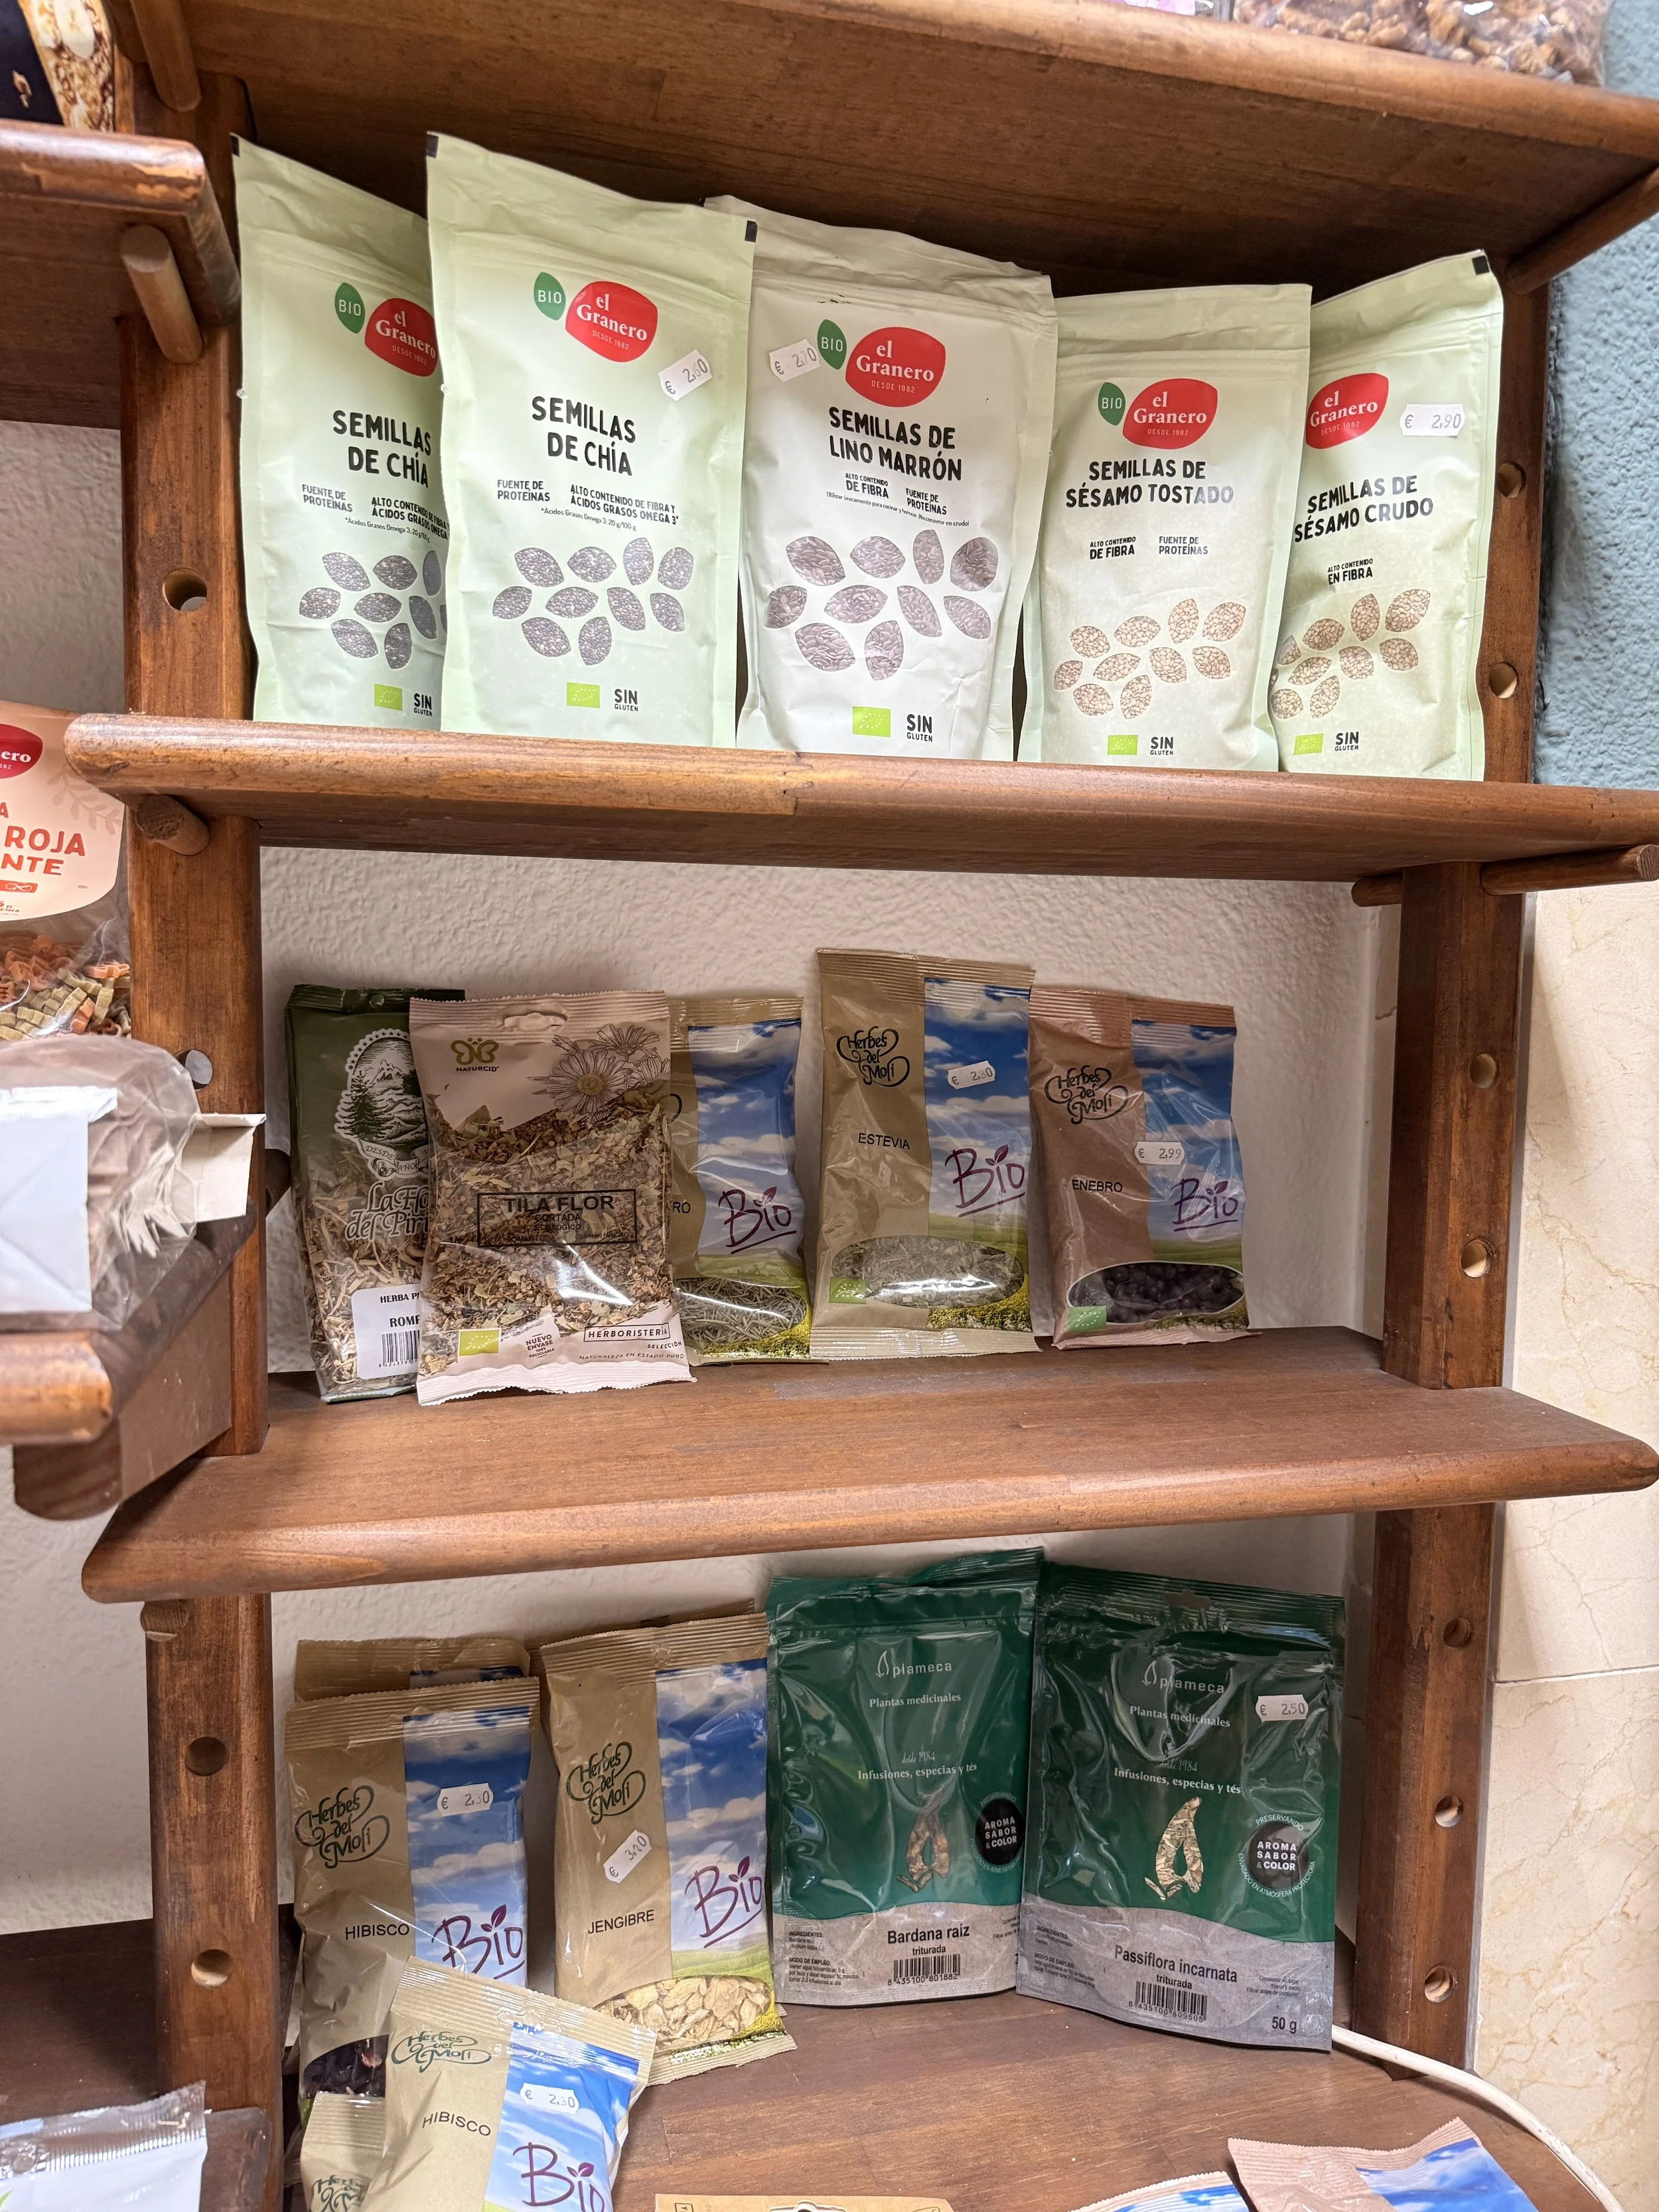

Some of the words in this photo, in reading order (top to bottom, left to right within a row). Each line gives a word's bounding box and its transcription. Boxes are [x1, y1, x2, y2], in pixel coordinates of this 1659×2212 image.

[538, 290, 562, 304] BIO
[596, 293, 610, 311] el
[339, 300, 361, 316] BIO
[394, 311, 406, 327] el
[576, 303, 648, 341] Granero
[821, 336, 843, 352] BIO
[876, 340, 893, 358] el
[774, 361, 784, 375] €
[856, 356, 934, 382] Granero
[666, 380, 676, 394] €
[1102, 397, 1122, 409] BIO
[1152, 391, 1167, 407] el
[1324, 391, 1339, 408] el
[532, 396, 636, 443] SEMILLAS
[1133, 408, 1207, 424] Granero
[1309, 402, 1379, 427] Granero
[1404, 414, 1413, 429] €
[1431, 413, 1462, 429] 2,90
[332, 409, 431, 456] SEMILLAS
[829, 407, 922, 446] SEMILLAS
[928, 425, 956, 449] DE
[547, 432, 578, 461] DE
[584, 441, 633, 476] CHÍA
[830, 435, 873, 464] LINO
[879, 446, 962, 481] MARRÓN
[348, 447, 380, 475] DE
[387, 451, 429, 488] CHÍA
[1089, 459, 1177, 480] SEMILLAS
[1183, 461, 1206, 479] DE
[302, 484, 332, 498] FUENTE
[334, 490, 346, 500] DE
[497, 480, 530, 489] FUENTE
[532, 481, 543, 490] DE
[846, 480, 859, 492] DE
[862, 482, 889, 499] FIBRA
[906, 488, 928, 501] FUENTE
[930, 494, 939, 503] DE
[1066, 482, 1142, 508] SÉSAMO
[1148, 484, 1234, 504] TOSTADO
[1307, 478, 1386, 514] SEMILLAS
[1392, 475, 1417, 495] DE
[1294, 506, 1360, 543] SÉSAMO
[1364, 498, 1434, 523] CRUDO
[1090, 548, 1103, 559] DE
[1106, 544, 1135, 558] FIBRA
[1328, 572, 1340, 585] EN
[1342, 566, 1373, 583] FIBRA
[414, 693, 432, 709] SIN
[614, 689, 638, 705] SIN
[614, 703, 638, 711] GLUTEN
[907, 714, 932, 733] SIN
[907, 732, 933, 743] GLUTEN
[1151, 737, 1174, 750] SIN
[1335, 732, 1359, 745] SIN
[5, 826, 86, 856] ROJA
[839, 1026, 893, 1055] Herbes
[952, 1076, 959, 1085] €
[1050, 1065, 1107, 1092] Herbes
[858, 1132, 910, 1151] ESTEVIA
[1138, 1147, 1144, 1159] €
[1159, 1147, 1181, 1159] 2,99
[945, 1145, 1025, 1209] Bio
[1072, 1179, 1123, 1192] ENEBRO
[367, 1181, 394, 1213] La
[504, 1197, 551, 1213] TILA
[557, 1195, 614, 1212] FLOR
[1172, 1178, 1238, 1224] Bio
[345, 1209, 385, 1240] del
[535, 1213, 581, 1222] CORTADA
[718, 1187, 792, 1248] Bio
[380, 1294, 409, 1303] HERBA
[526, 1334, 552, 1345] NUEVO
[589, 1328, 668, 1338] HERBORISTERÍA
[528, 1340, 553, 1351] ENVASE
[893, 1662, 952, 1678] plameca
[869, 1698, 904, 1708] Plantas
[906, 1692, 961, 1705] medicinales
[1129, 1706, 1167, 1719] Plantas
[1171, 1713, 1230, 1727] medicinales
[1260, 1704, 1267, 1716] €
[572, 1742, 626, 1783] Herbes
[1115, 1767, 1169, 1785] Infusiones,
[1173, 1779, 1214, 1791] especias
[1218, 1785, 1223, 1793] y
[1226, 1784, 1241, 1794] tés
[302, 1787, 366, 1828] Herbes
[441, 1797, 448, 1809] €
[985, 1816, 1015, 1830] AROMA
[1256, 1814, 1303, 1830] PRESERVANDO
[985, 1826, 1017, 1839] SABOR
[1258, 1841, 1297, 1851] AROMA
[1257, 1851, 1296, 1861] SABOR
[609, 1866, 618, 1877] €
[1263, 1861, 1295, 1870] COLOR
[1238, 1853, 1253, 1884] ENVASADO
[1260, 1888, 1292, 1897] ATMÓSFERA
[1292, 1861, 1315, 1893] PROTECTORA
[685, 1856, 762, 1937] Bio
[588, 1909, 655, 1935] JENGIBRE
[346, 1923, 409, 1940] HIBISCO
[432, 1905, 524, 1974] Bio
[888, 1928, 943, 1944] Bardana
[947, 1923, 970, 1939] raíz
[912, 1945, 946, 1955] triturada
[1115, 1945, 1175, 1971] Passiflora
[1179, 1959, 1238, 1982] incarnata
[1156, 1974, 1192, 1990] triturada
[1272, 2016, 1285, 2029] 50
[1289, 2020, 1297, 2034] g
[524, 2090, 534, 2101] €
[422, 2111, 491, 2137] HIBISCO
[512, 2142, 605, 2212] Bio
